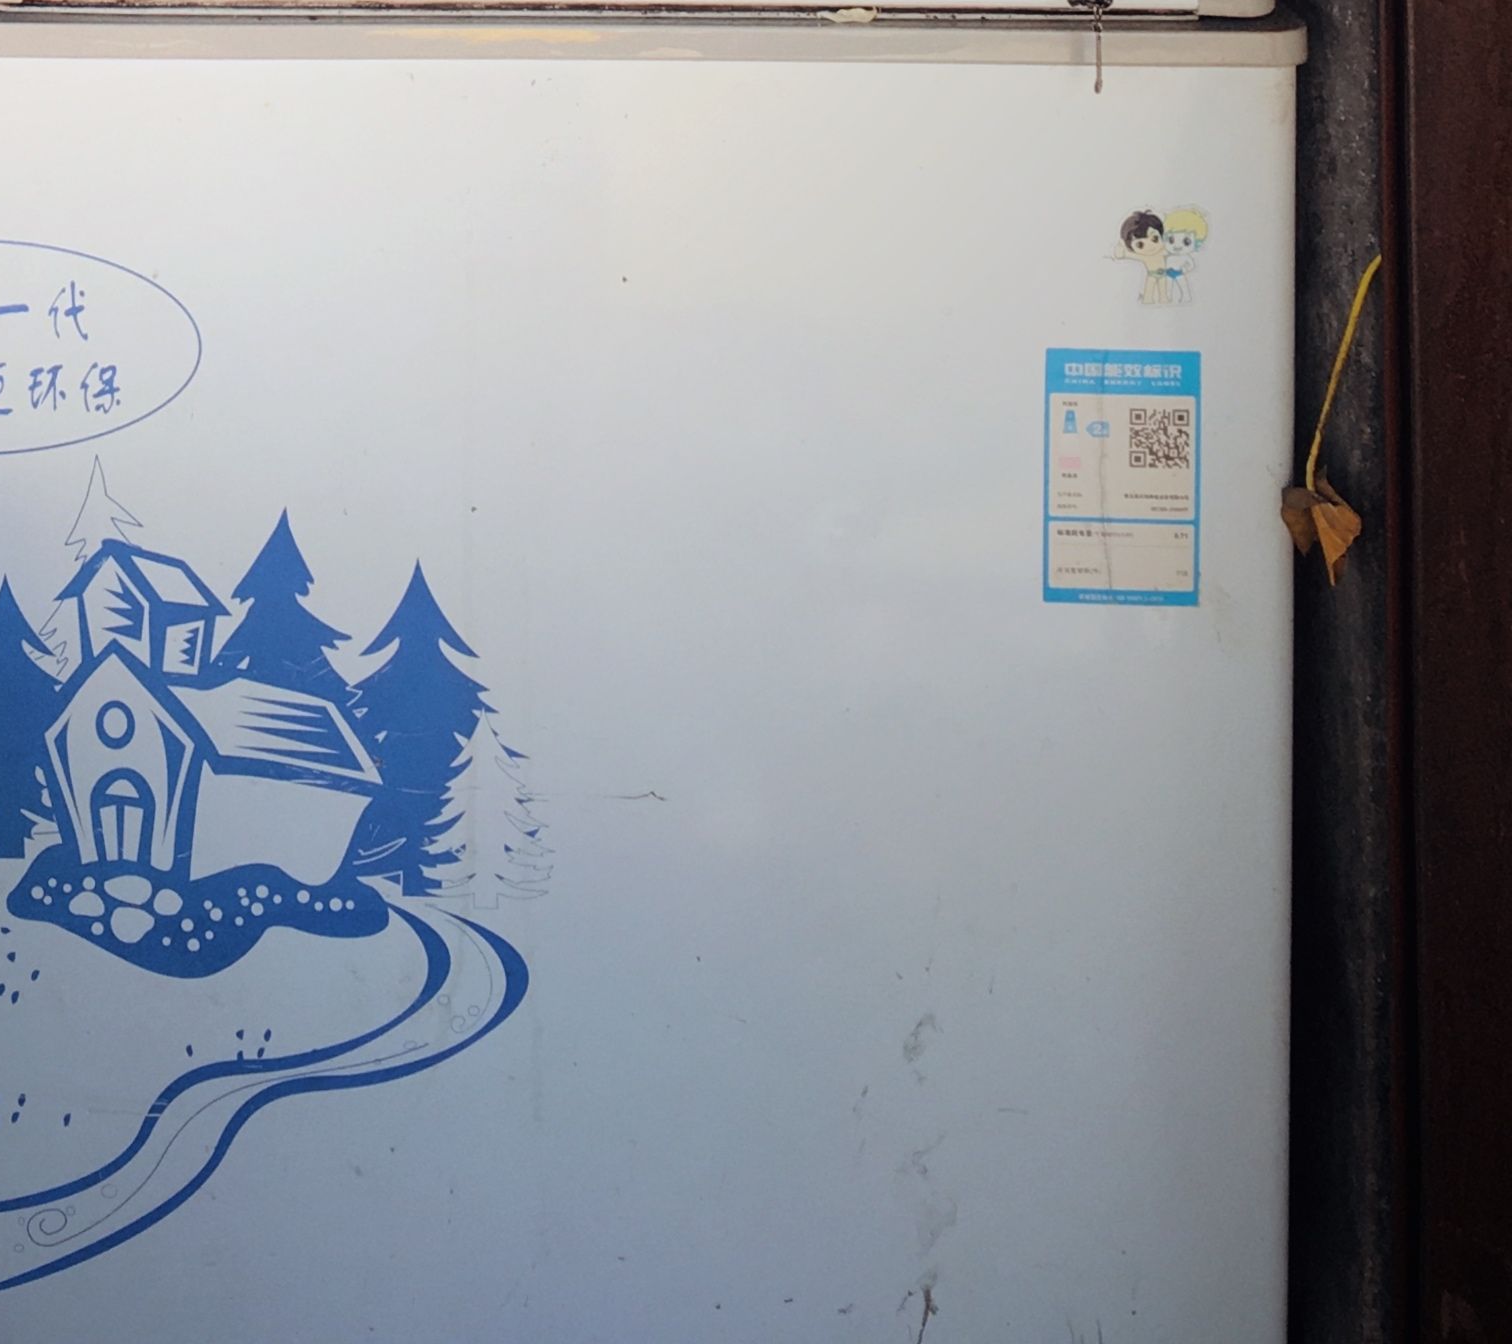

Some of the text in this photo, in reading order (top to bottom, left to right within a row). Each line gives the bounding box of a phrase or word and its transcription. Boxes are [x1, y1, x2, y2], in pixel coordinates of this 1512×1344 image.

[1064, 362, 1183, 380] 中国能效标识
